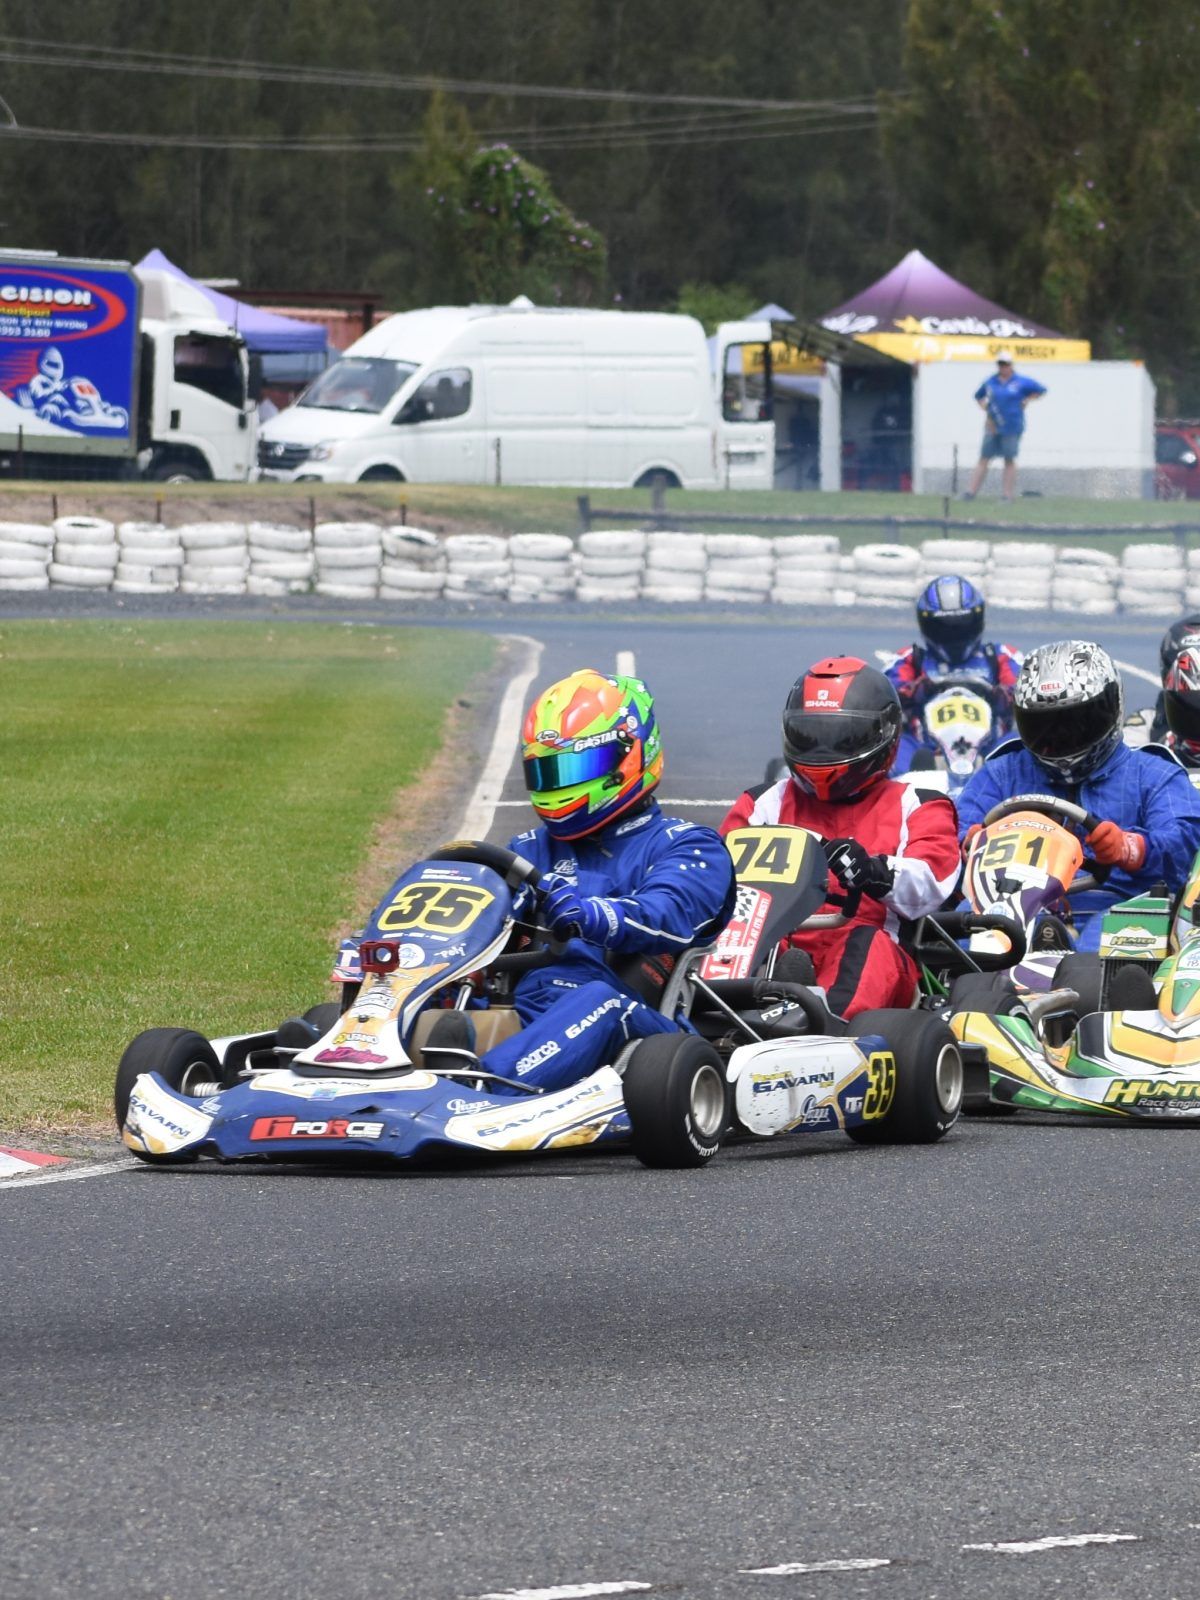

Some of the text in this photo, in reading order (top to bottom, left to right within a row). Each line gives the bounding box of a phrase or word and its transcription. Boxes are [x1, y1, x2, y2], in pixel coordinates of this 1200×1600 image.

[1040, 682, 1063, 691] BELL
[804, 700, 840, 708] SHARK
[937, 704, 981, 723] 69
[732, 836, 792, 875] 74
[983, 834, 1045, 868] 51
[381, 885, 491, 931] 35
[753, 1071, 835, 1094] GAVARNI
[864, 1054, 897, 1118] 35
[130, 1094, 191, 1137] GAVARNI
[476, 1084, 603, 1138] GAVARNI
[1137, 1098, 1166, 1108] Race
